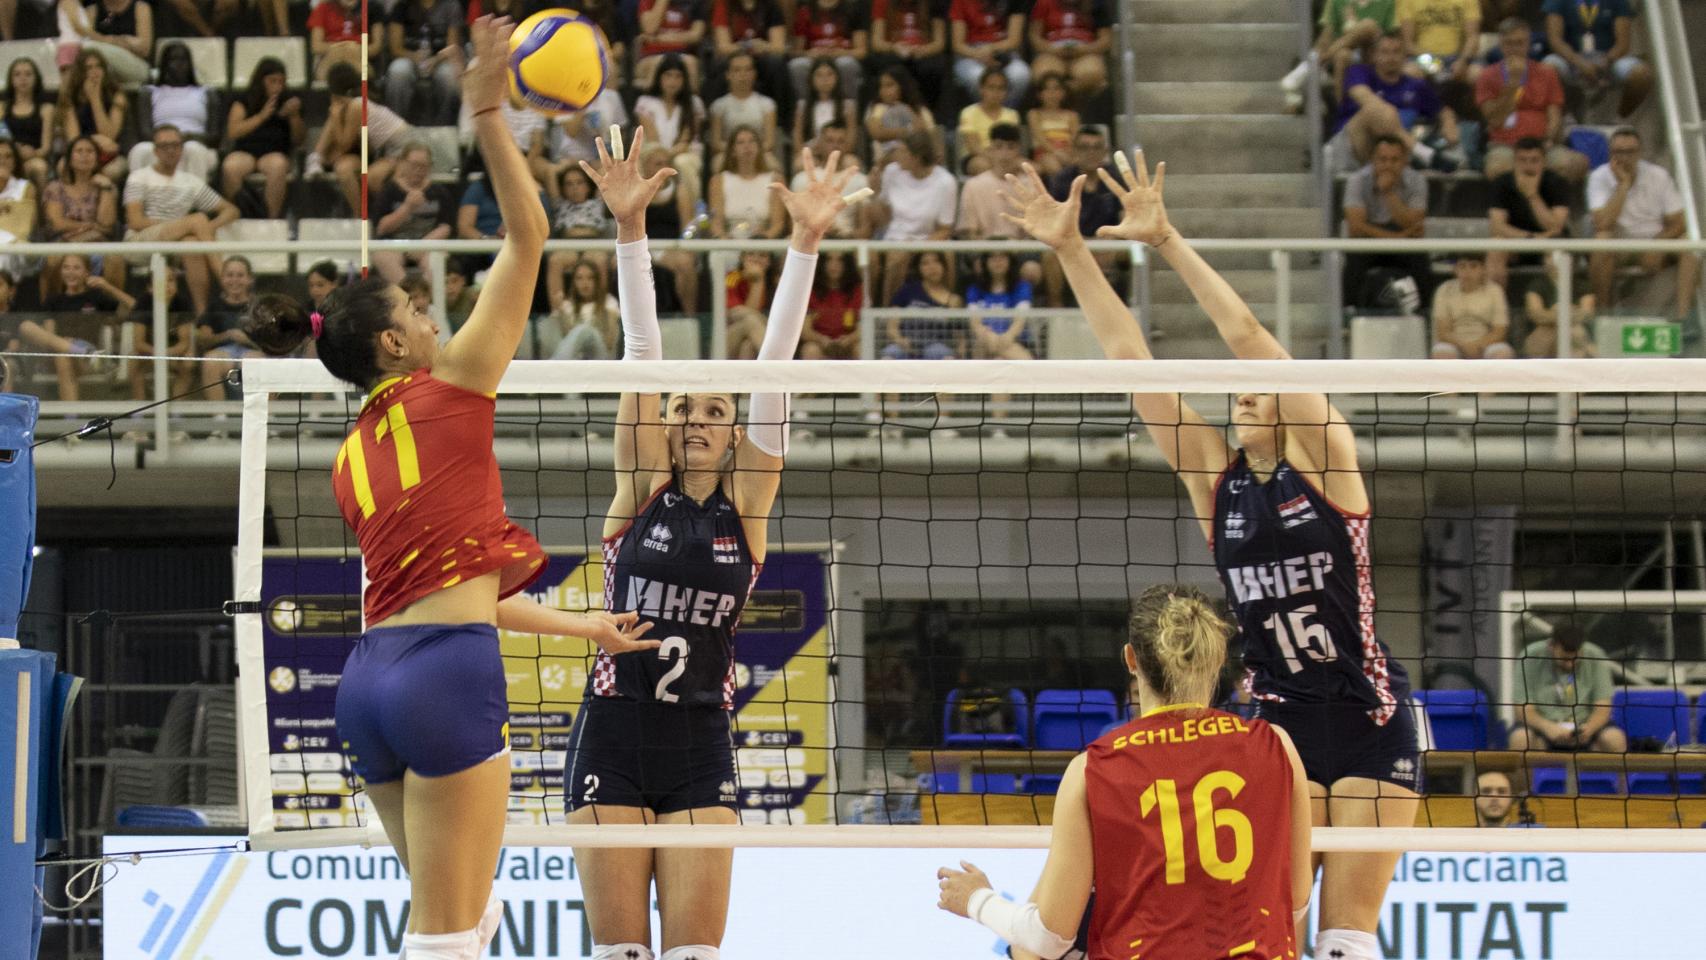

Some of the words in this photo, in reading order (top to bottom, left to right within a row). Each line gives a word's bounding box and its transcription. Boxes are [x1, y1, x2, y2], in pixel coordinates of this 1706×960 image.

[336, 402, 422, 520] 11
[1262, 604, 1339, 674] 15
[655, 636, 691, 703] 2
[1113, 716, 1250, 750] SCHLEGEL
[583, 774, 600, 802] 2
[1139, 770, 1254, 885] 16
[267, 850, 401, 880] Comun
[1393, 851, 1569, 882] lenciana
